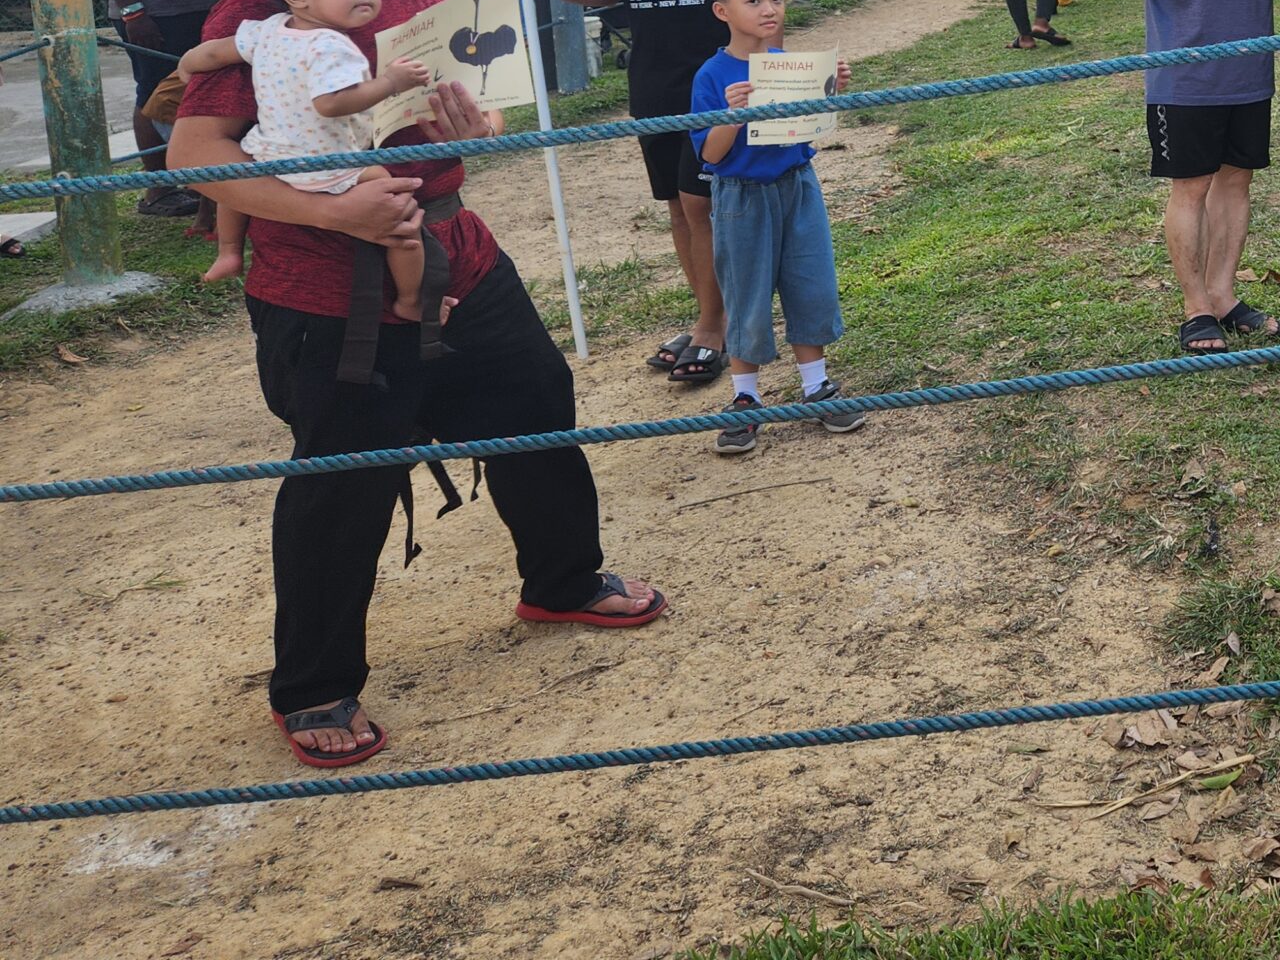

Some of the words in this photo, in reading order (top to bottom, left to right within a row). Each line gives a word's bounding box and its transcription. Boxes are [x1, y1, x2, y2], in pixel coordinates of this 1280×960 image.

[659, 0, 677, 8] NEW
[390, 16, 436, 49] TAHNIAH
[761, 60, 814, 71] TAHNIAH
